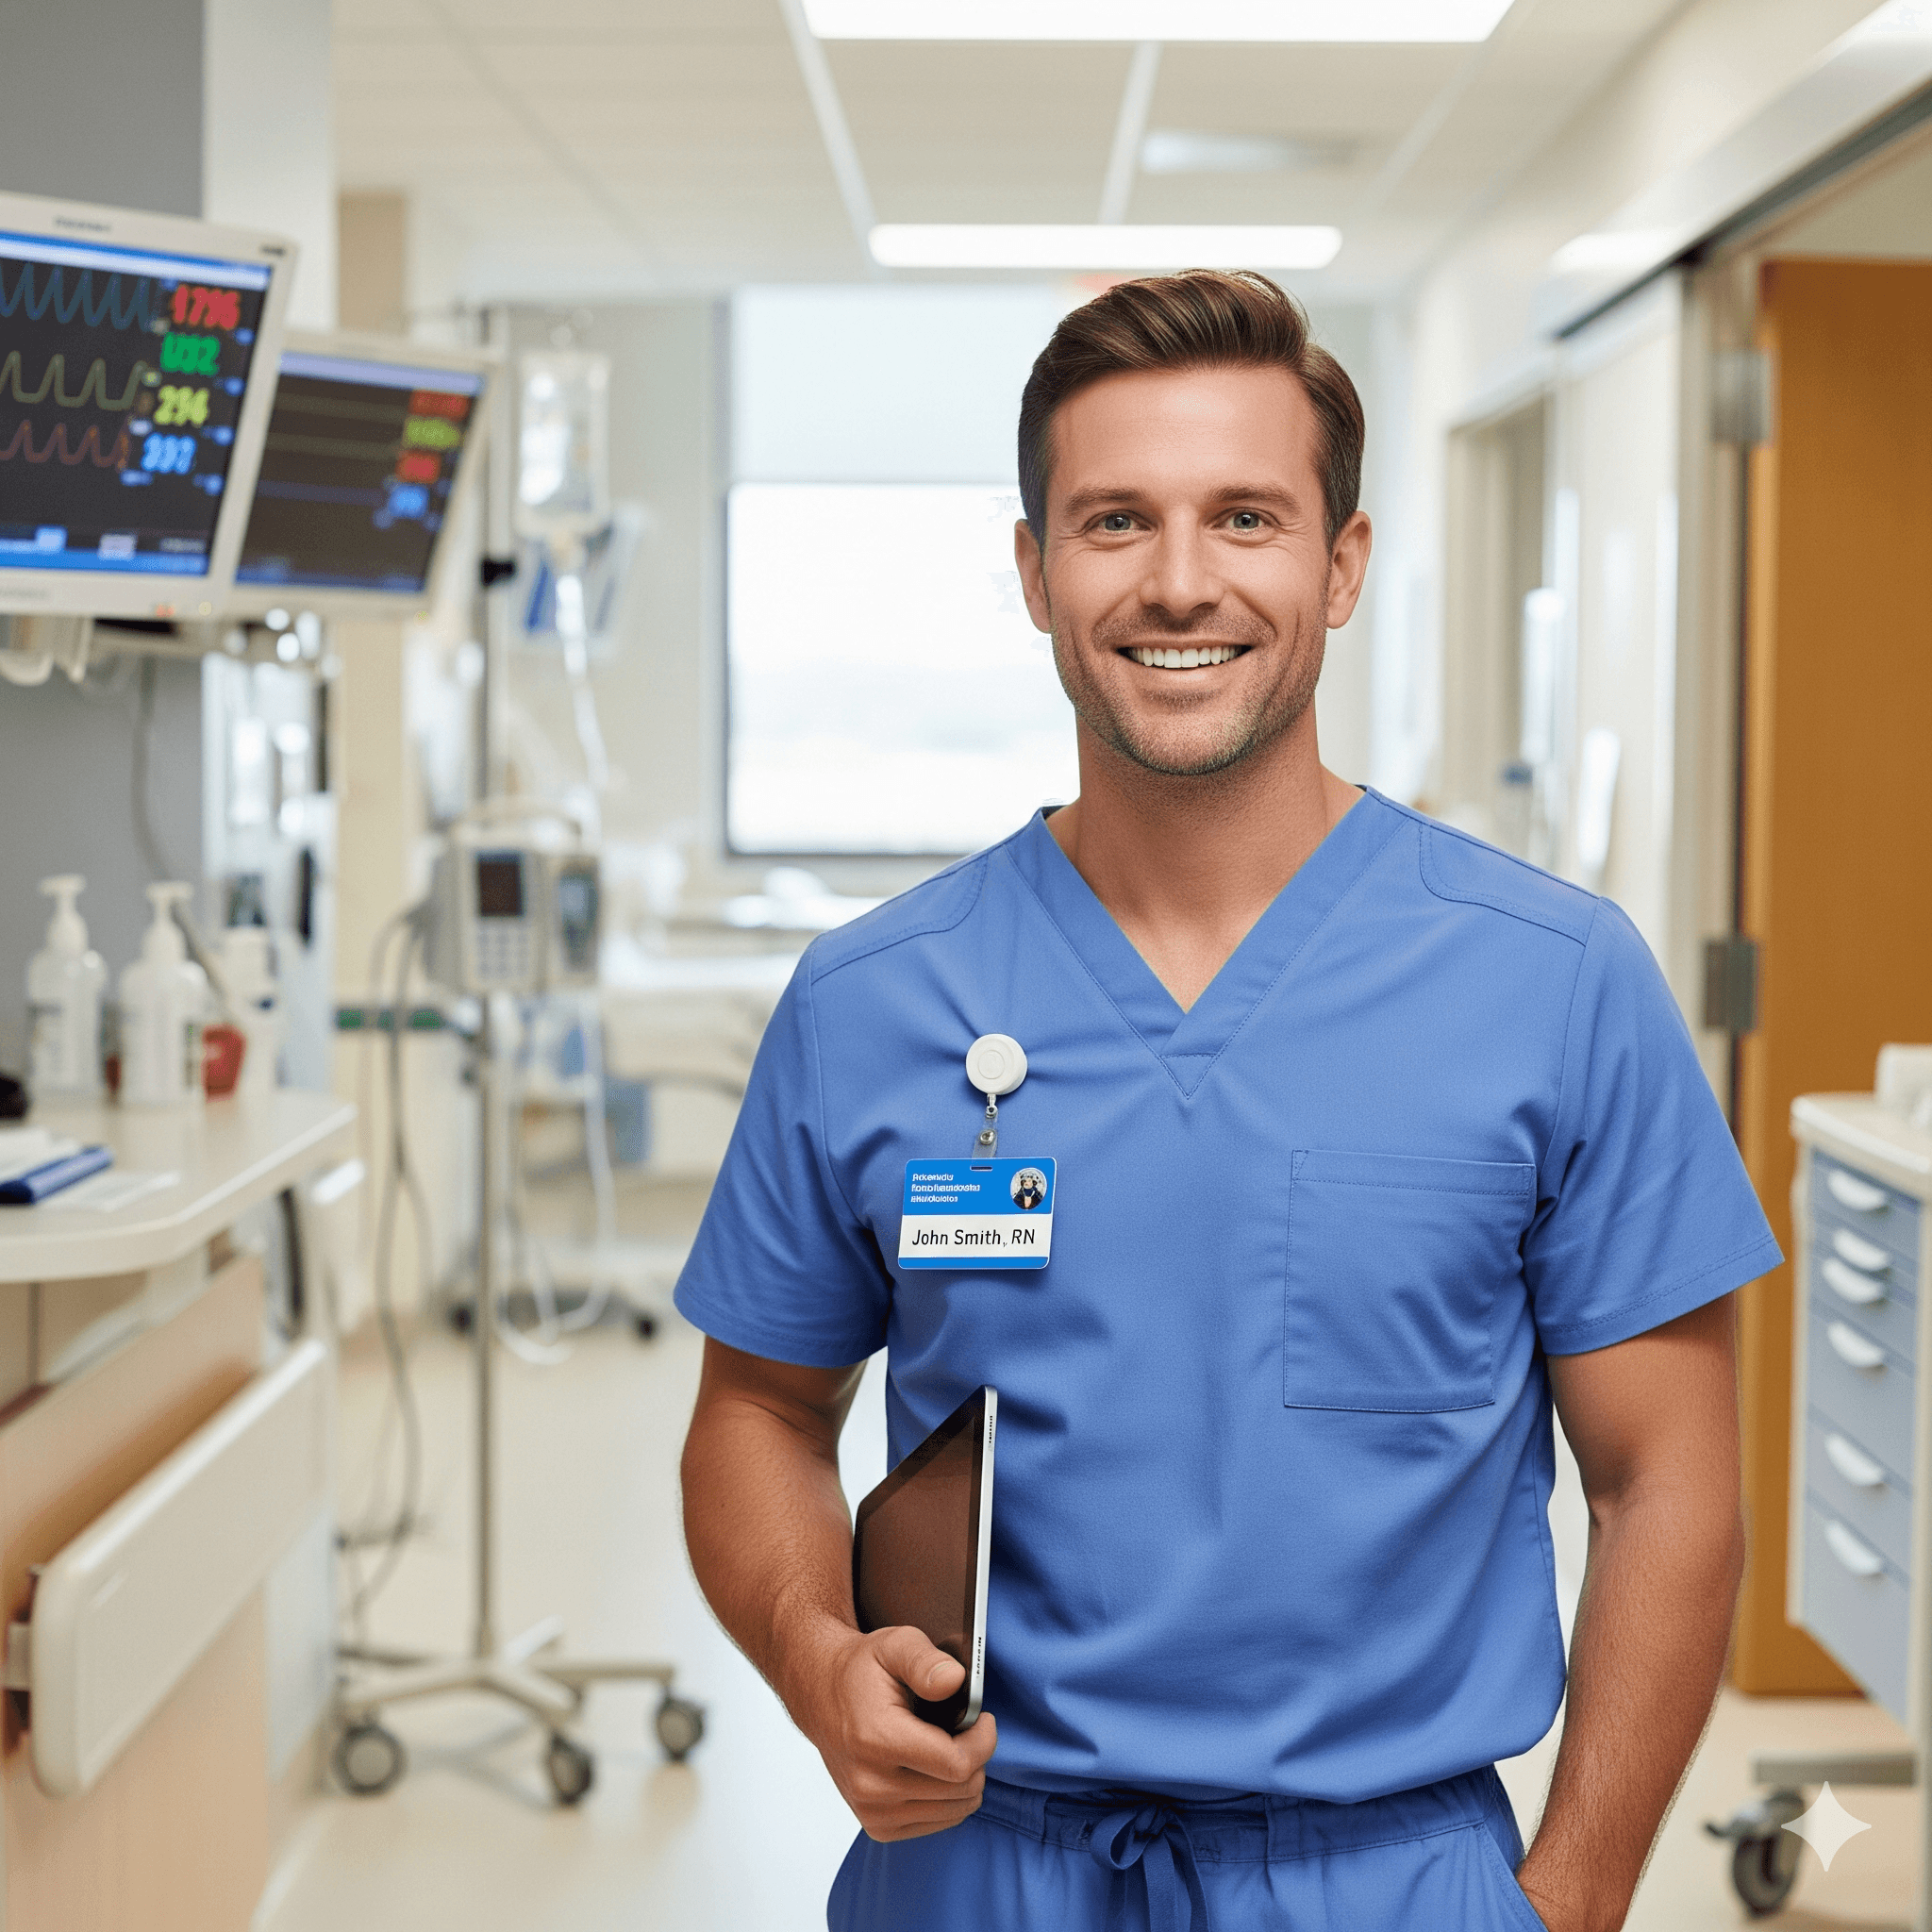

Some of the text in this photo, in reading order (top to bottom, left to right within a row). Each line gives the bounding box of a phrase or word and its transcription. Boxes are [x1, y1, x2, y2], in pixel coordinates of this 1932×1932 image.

[912, 1229, 1036, 1248] John Smith, RN
